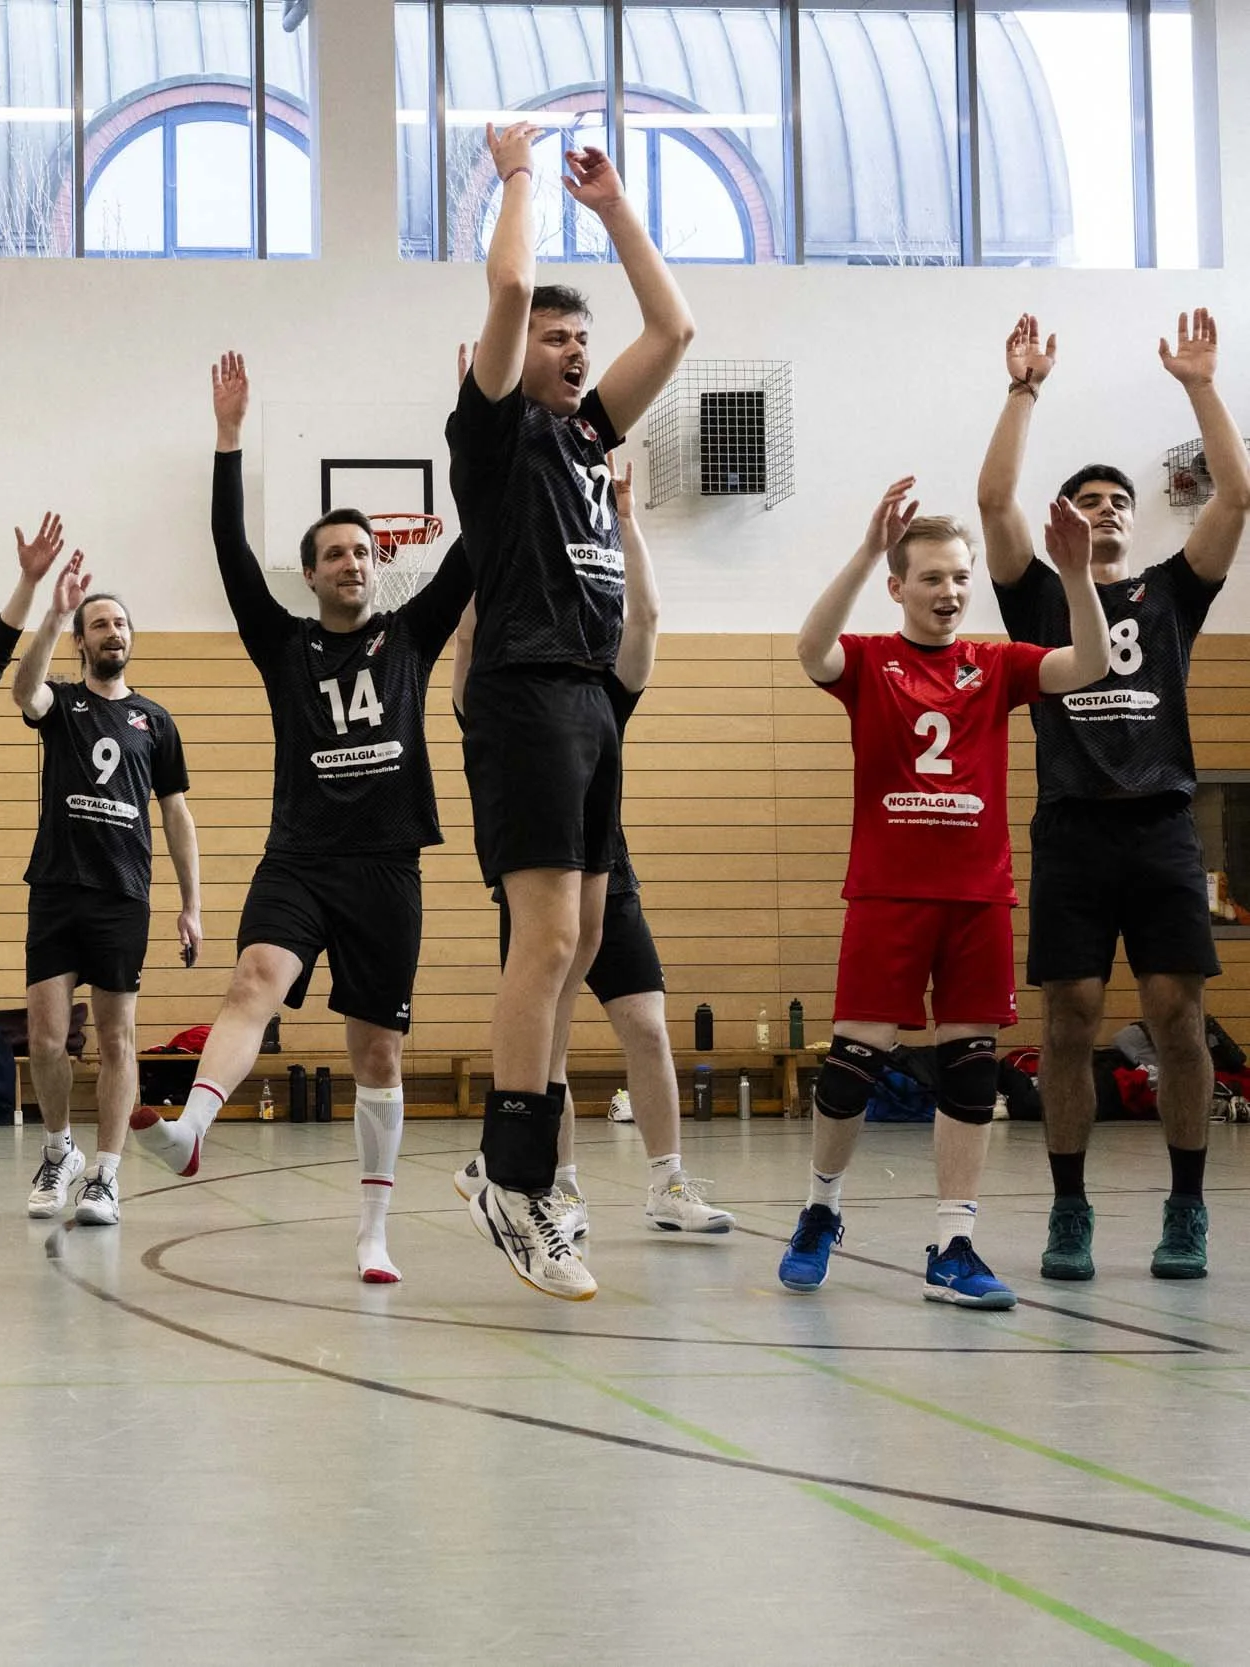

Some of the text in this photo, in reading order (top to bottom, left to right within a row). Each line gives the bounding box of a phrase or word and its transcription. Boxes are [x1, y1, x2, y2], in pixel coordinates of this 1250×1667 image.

[318, 668, 385, 735] 14
[1068, 694, 1132, 707] NOSTALGIA
[914, 711, 953, 775] 2
[92, 737, 121, 785] 9
[316, 750, 377, 764] NOSTALGIA
[70, 798, 117, 812] NOSTALGIA
[888, 797, 957, 809] NOSTALGIA
